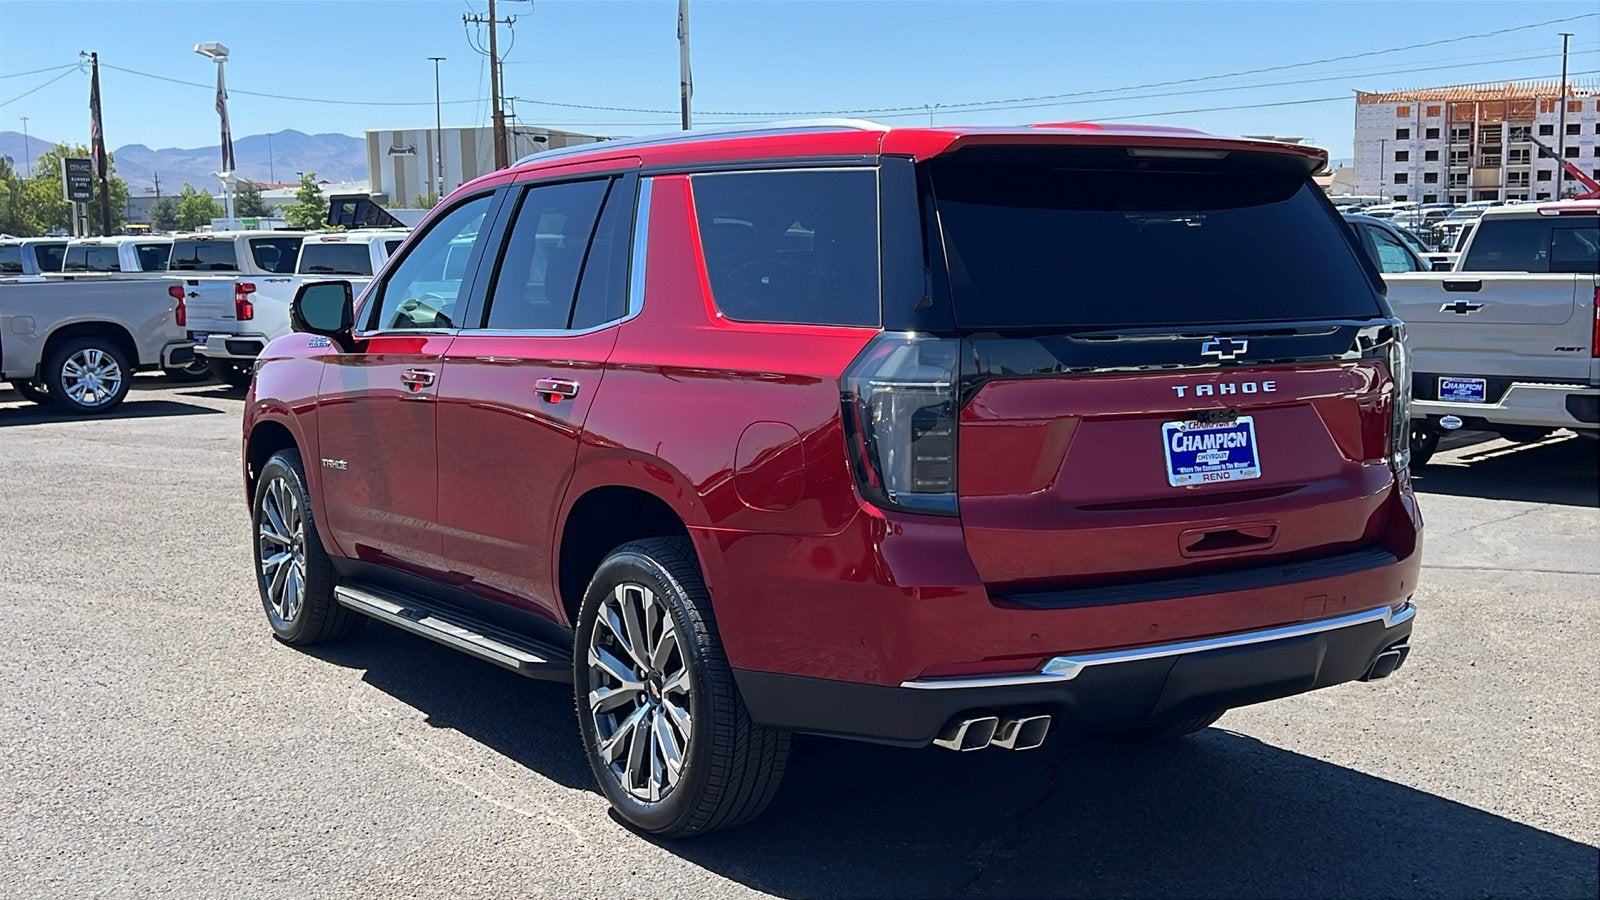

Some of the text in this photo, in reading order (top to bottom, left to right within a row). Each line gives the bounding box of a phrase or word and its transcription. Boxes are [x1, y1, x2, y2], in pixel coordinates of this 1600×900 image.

[1172, 381, 1277, 398] TAHOE
[1442, 381, 1483, 391] CHAMPION
[1172, 431, 1247, 453] CHAMPION
[321, 458, 349, 470] TAHOE
[1203, 471, 1231, 481] RENO
